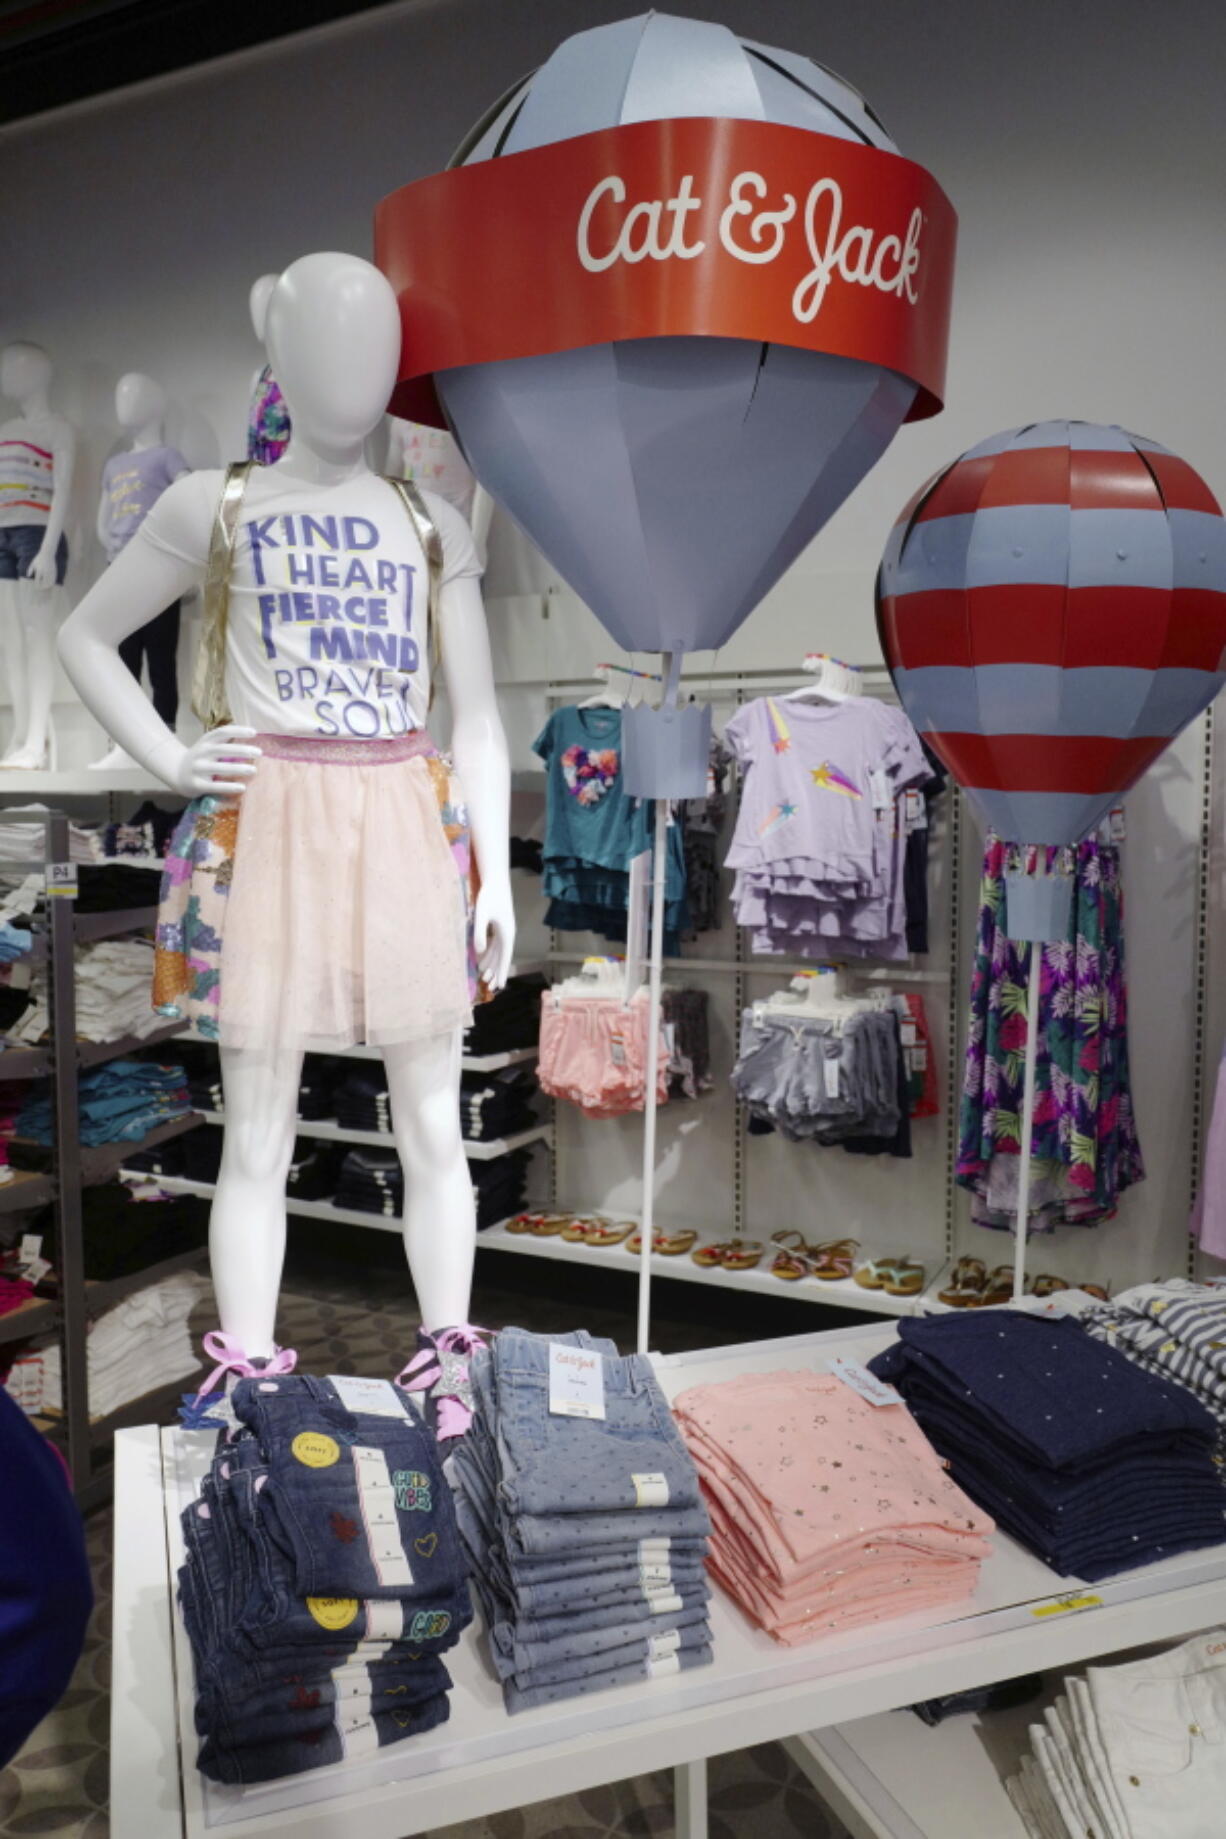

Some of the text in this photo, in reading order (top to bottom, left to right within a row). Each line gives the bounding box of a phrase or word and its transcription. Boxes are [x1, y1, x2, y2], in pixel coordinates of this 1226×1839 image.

[577, 171, 921, 324] Cat & Jack
[248, 515, 380, 585] KIND
[258, 592, 389, 659] FIERCE
[287, 554, 417, 632] HEART
[275, 667, 394, 701] BRAVE
[310, 627, 419, 673] MIND
